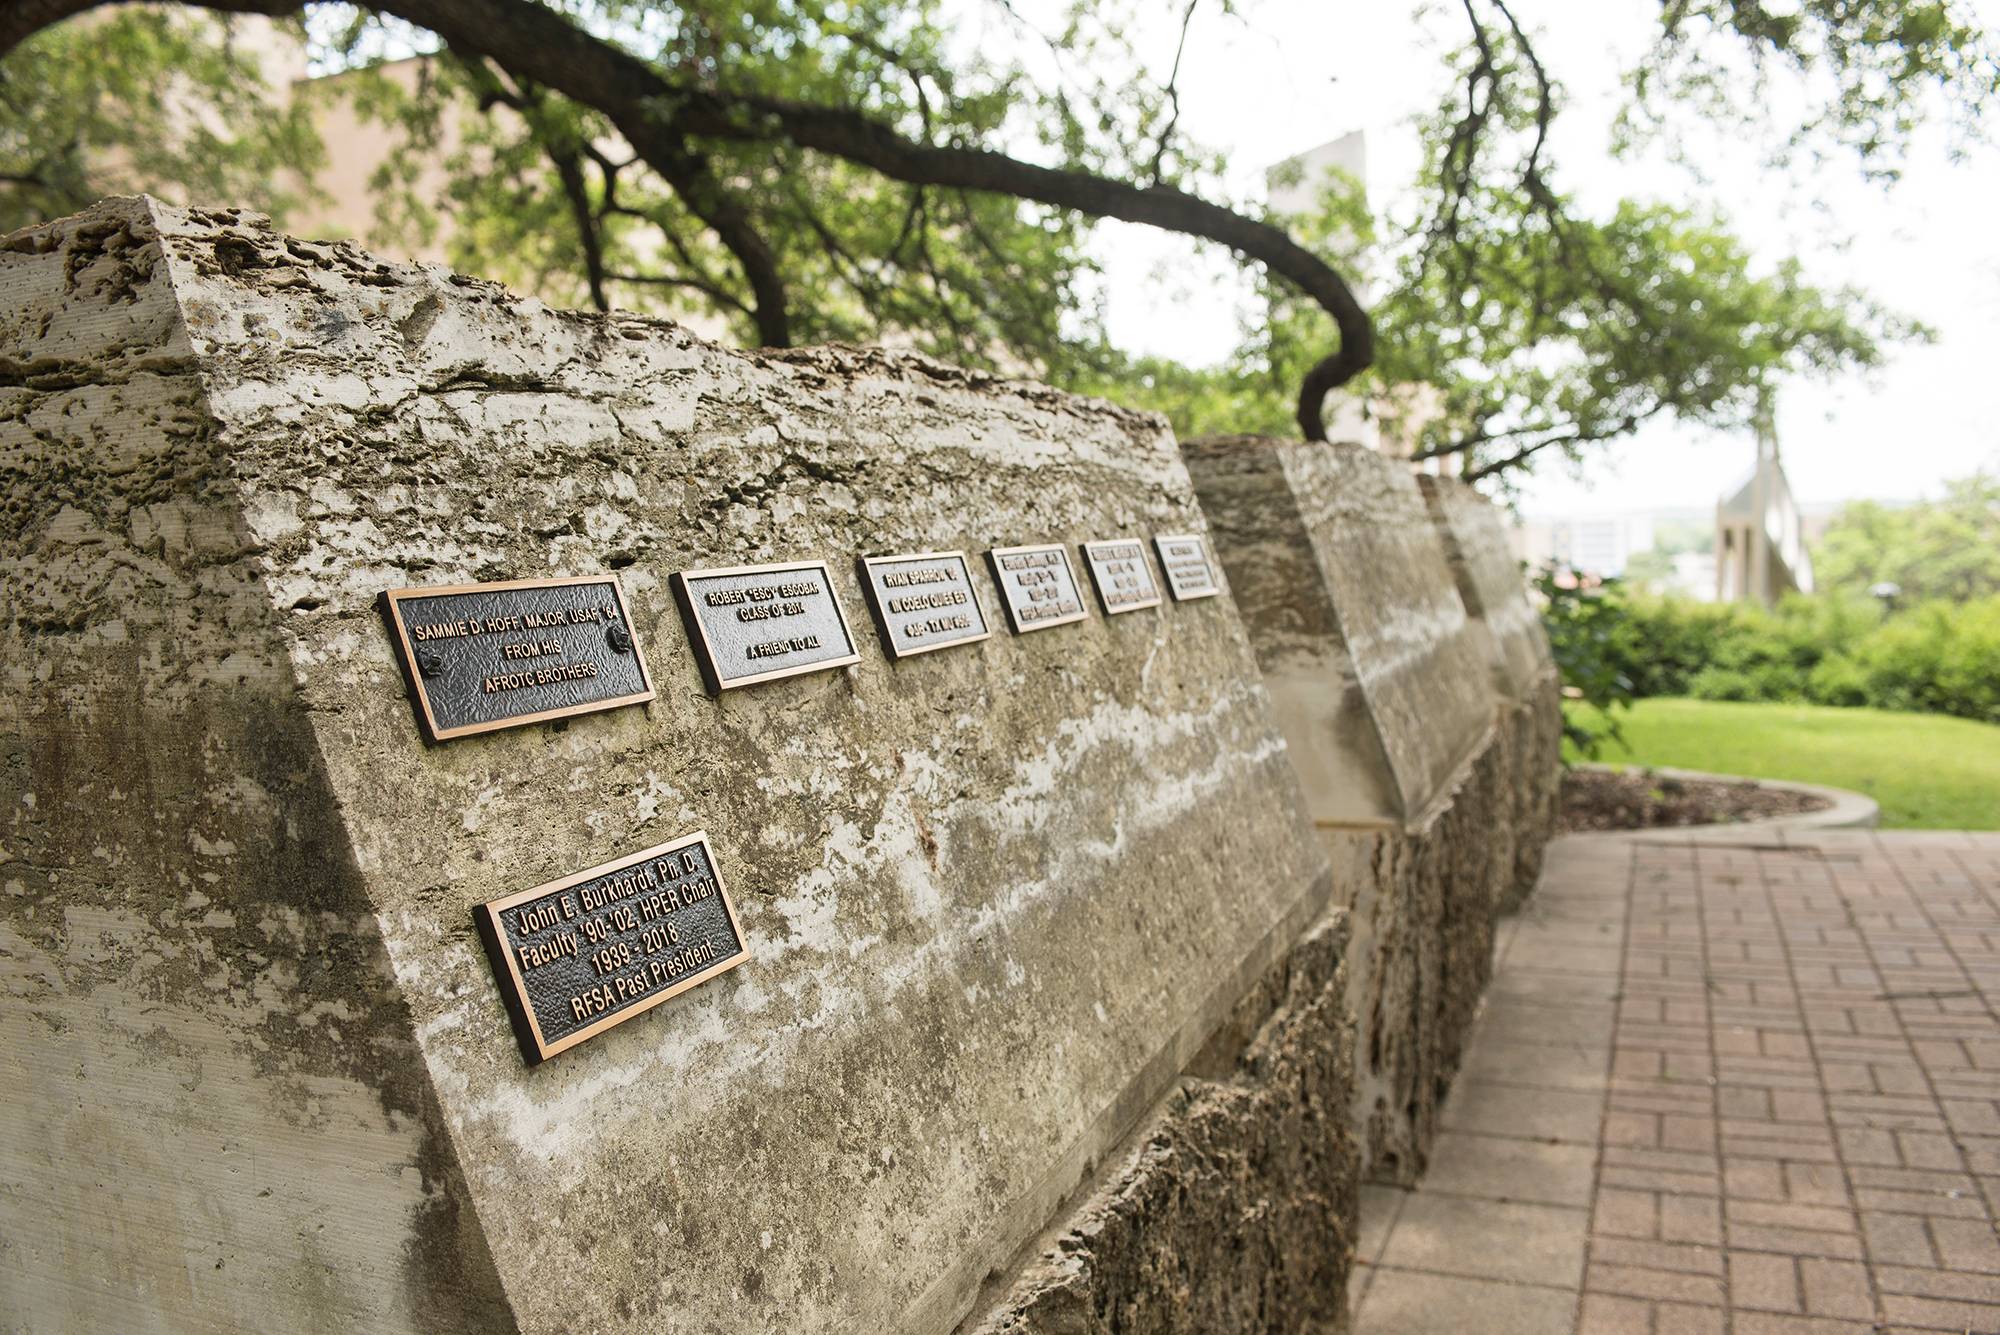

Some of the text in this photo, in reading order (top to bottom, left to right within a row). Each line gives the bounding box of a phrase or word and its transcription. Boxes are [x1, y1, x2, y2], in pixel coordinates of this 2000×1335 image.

[709, 590, 746, 606] ROBERT
[783, 582, 820, 597] ESCOBAR
[740, 606, 770, 620] CLASS
[773, 605, 785, 617] OF
[416, 621, 468, 641] SAMMIE
[469, 619, 485, 633] D.
[505, 639, 562, 659] FROM HIS
[751, 636, 821, 658] A FRIEND TO ALL
[485, 662, 598, 693] AFROTC BROTHERS
[520, 852, 700, 935] John E. Burkhardt, Ph. D.
[518, 932, 578, 971] Faculty
[641, 893, 680, 923] HPER
[681, 877, 716, 904] Chair
[592, 944, 630, 975] 1939
[642, 922, 678, 954] 2018
[570, 940, 715, 1021] RFSA Past President
